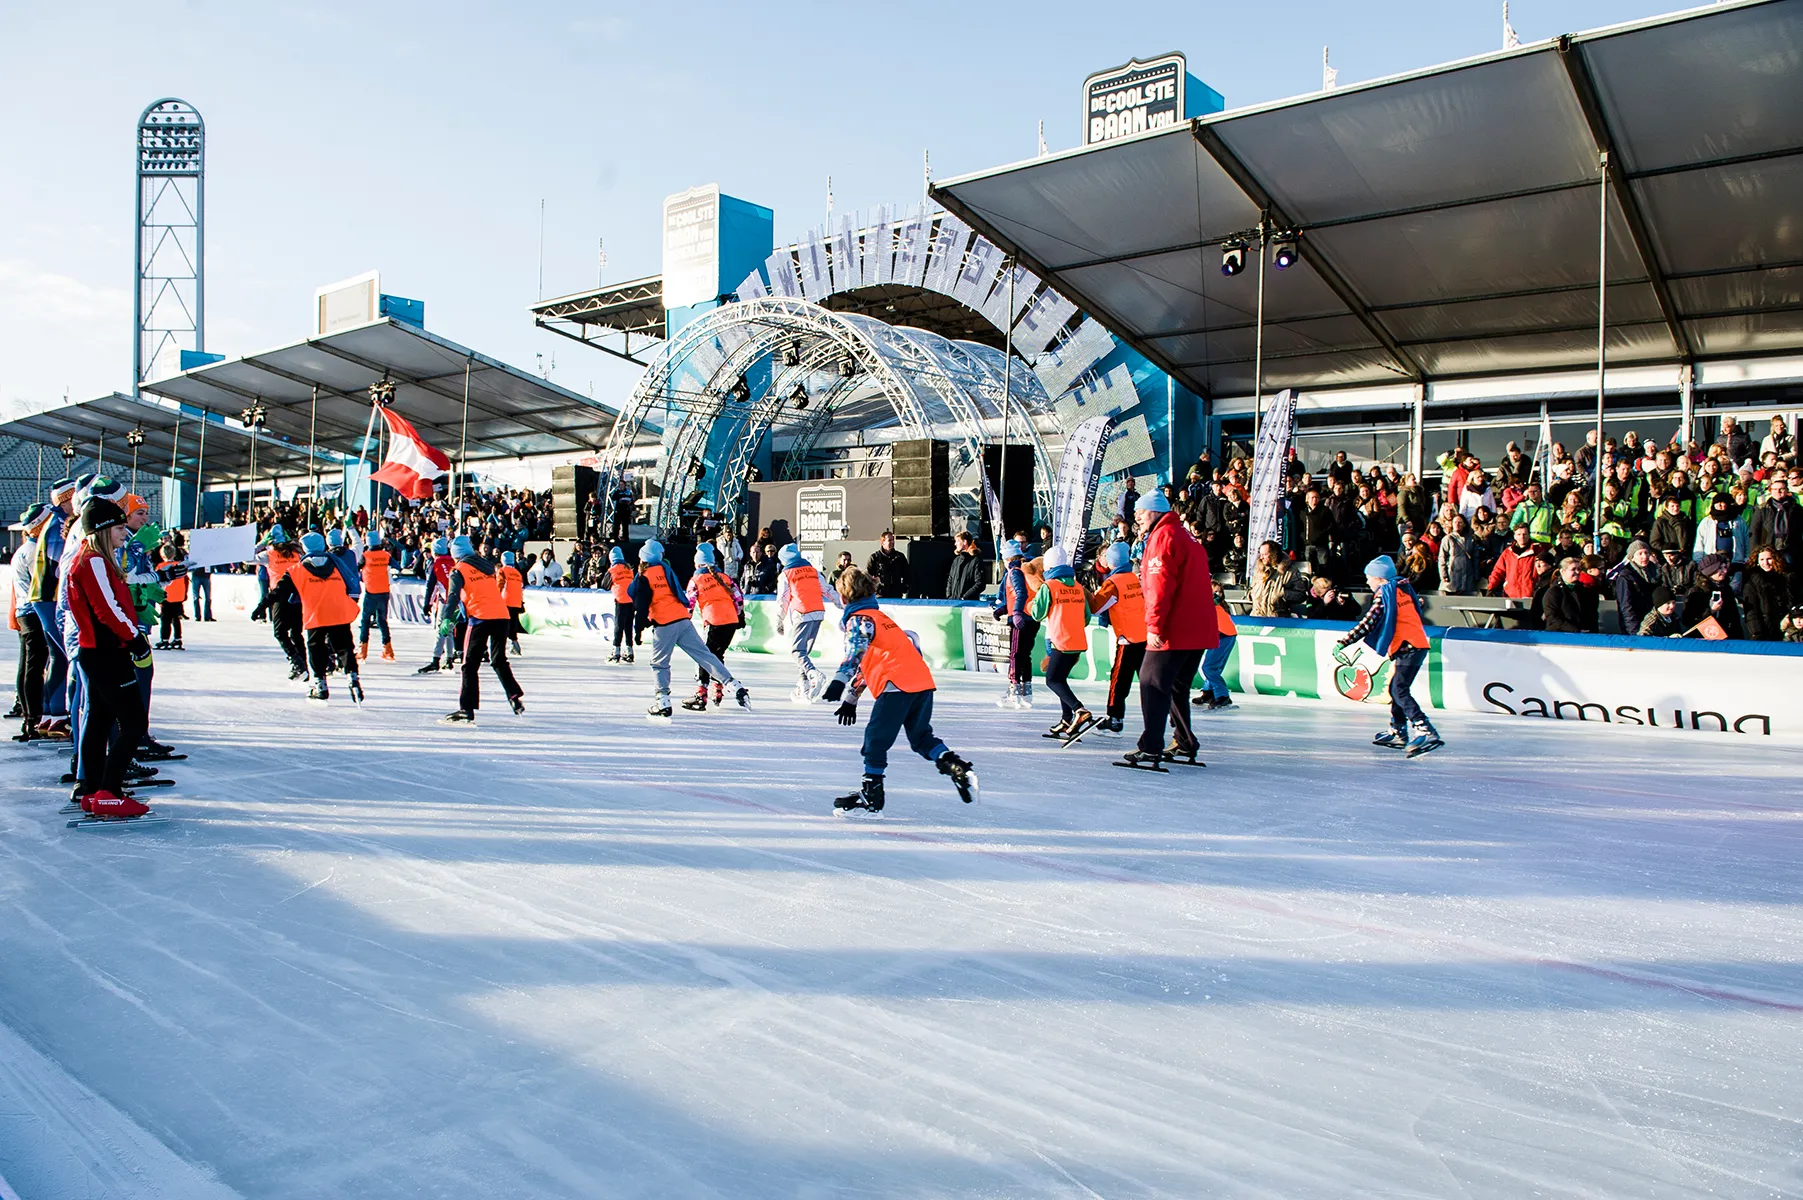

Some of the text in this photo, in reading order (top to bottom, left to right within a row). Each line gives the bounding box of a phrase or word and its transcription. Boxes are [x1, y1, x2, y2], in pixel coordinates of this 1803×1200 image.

[1091, 78, 1175, 113] DE COOLSTE
[1090, 106, 1175, 142] BAAN VAN
[808, 499, 842, 513] COOLSTE
[801, 513, 828, 530] BAAN
